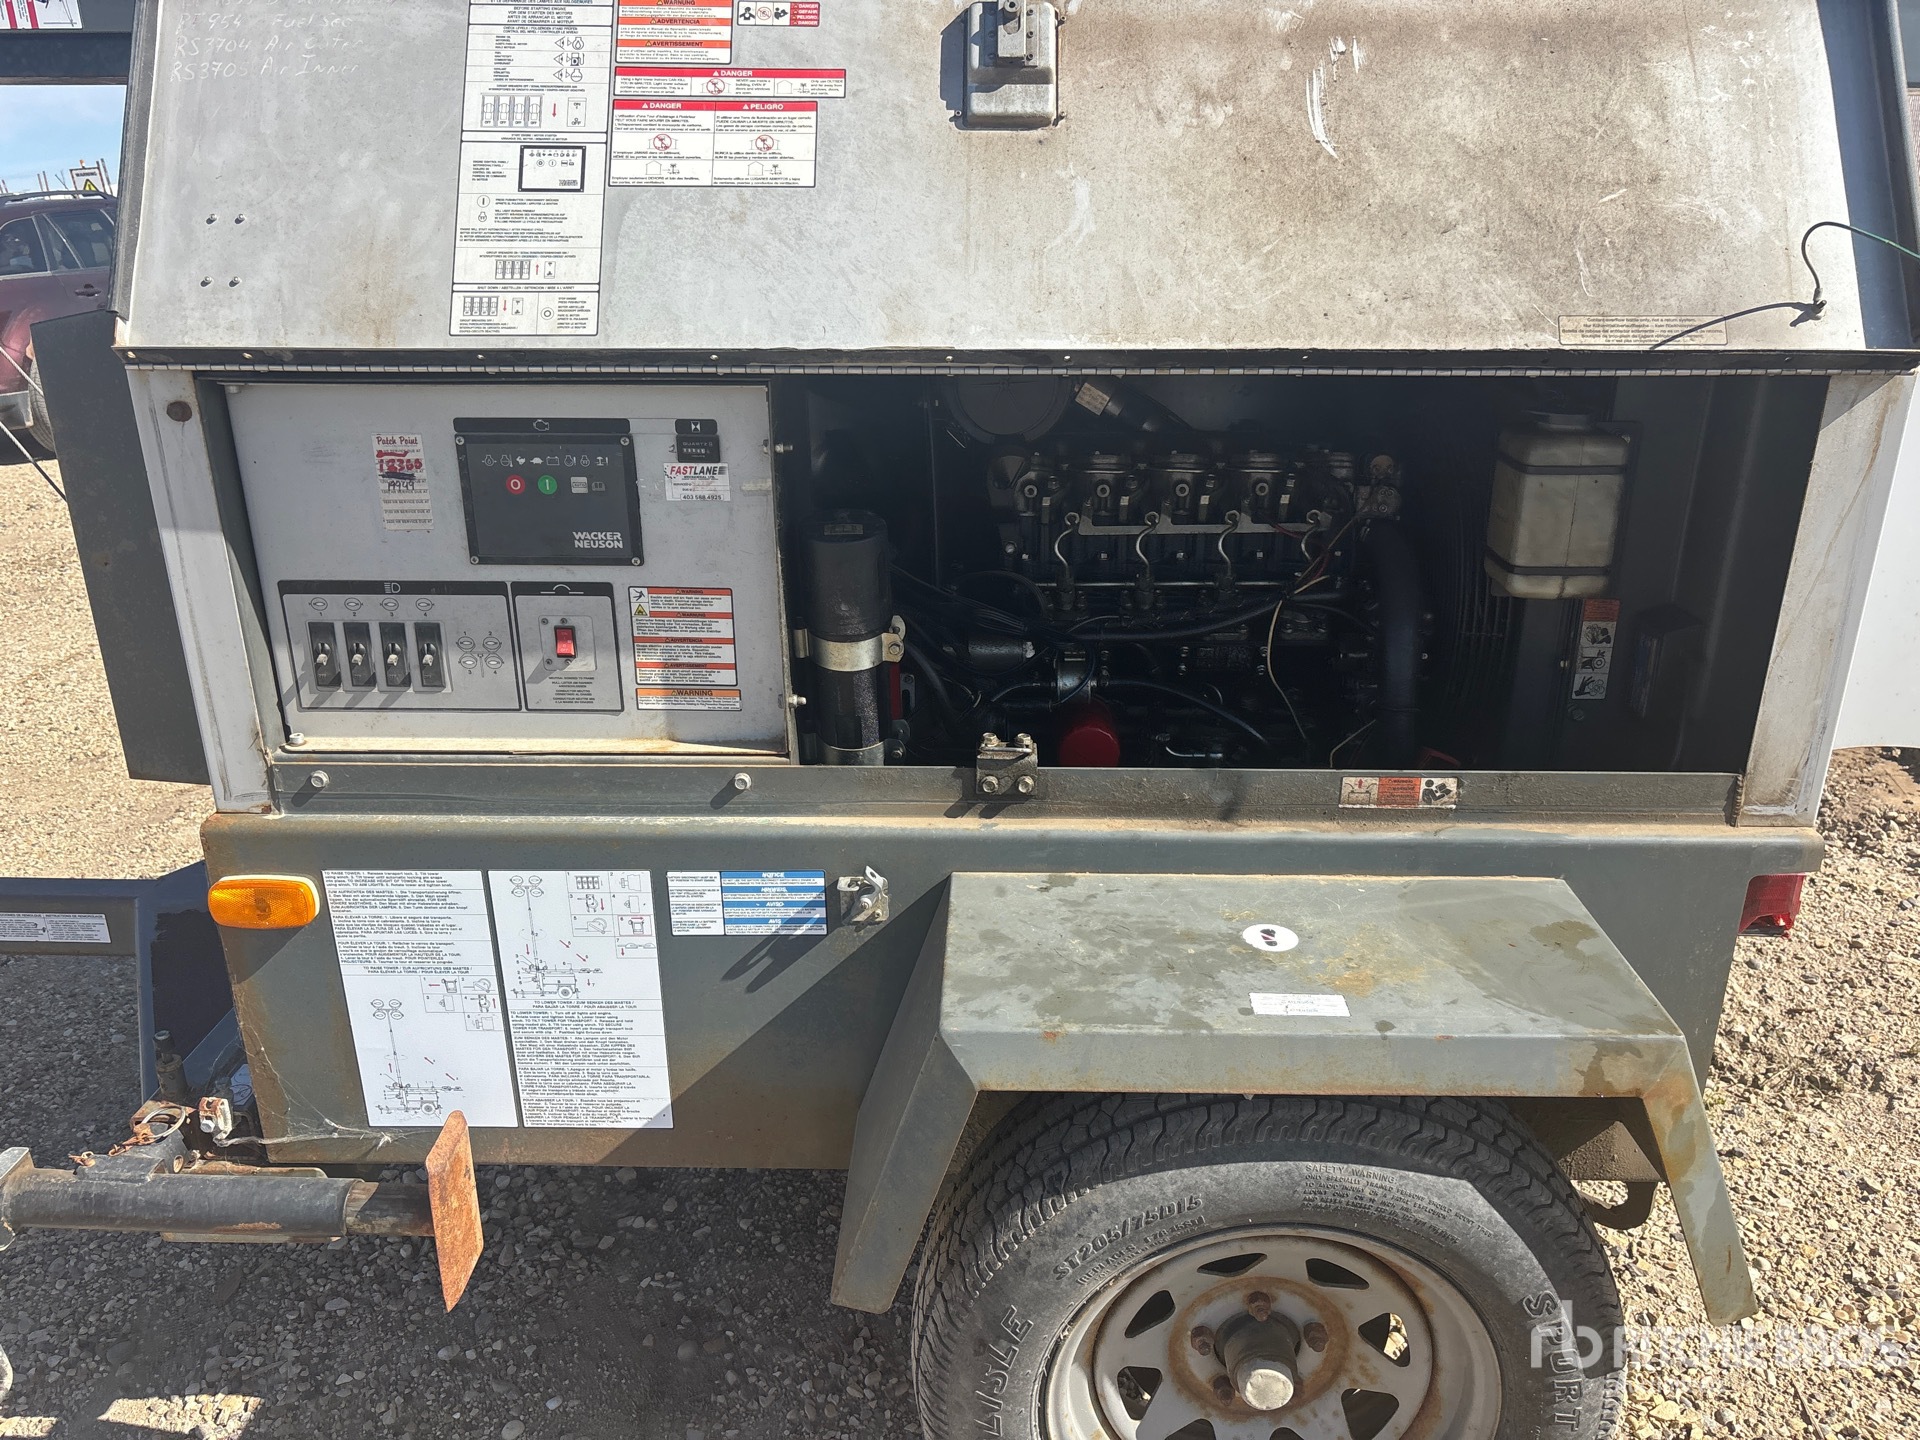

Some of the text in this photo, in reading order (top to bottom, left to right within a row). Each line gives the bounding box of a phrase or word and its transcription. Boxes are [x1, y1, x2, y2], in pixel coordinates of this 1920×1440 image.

[264, 35, 293, 51] Air
[170, 61, 248, 82] RS3705
[260, 56, 288, 75] Air
[376, 436, 418, 445] Patch Point
[670, 466, 718, 475] FASTLANE
[572, 532, 622, 540] WACKER
[574, 540, 623, 548] NEUSON
[1306, 1164, 1397, 1184] SAFETY WARNING:
[1052, 1193, 1203, 1281] ST205/75D15
[1522, 1290, 1583, 1432] SPORT
